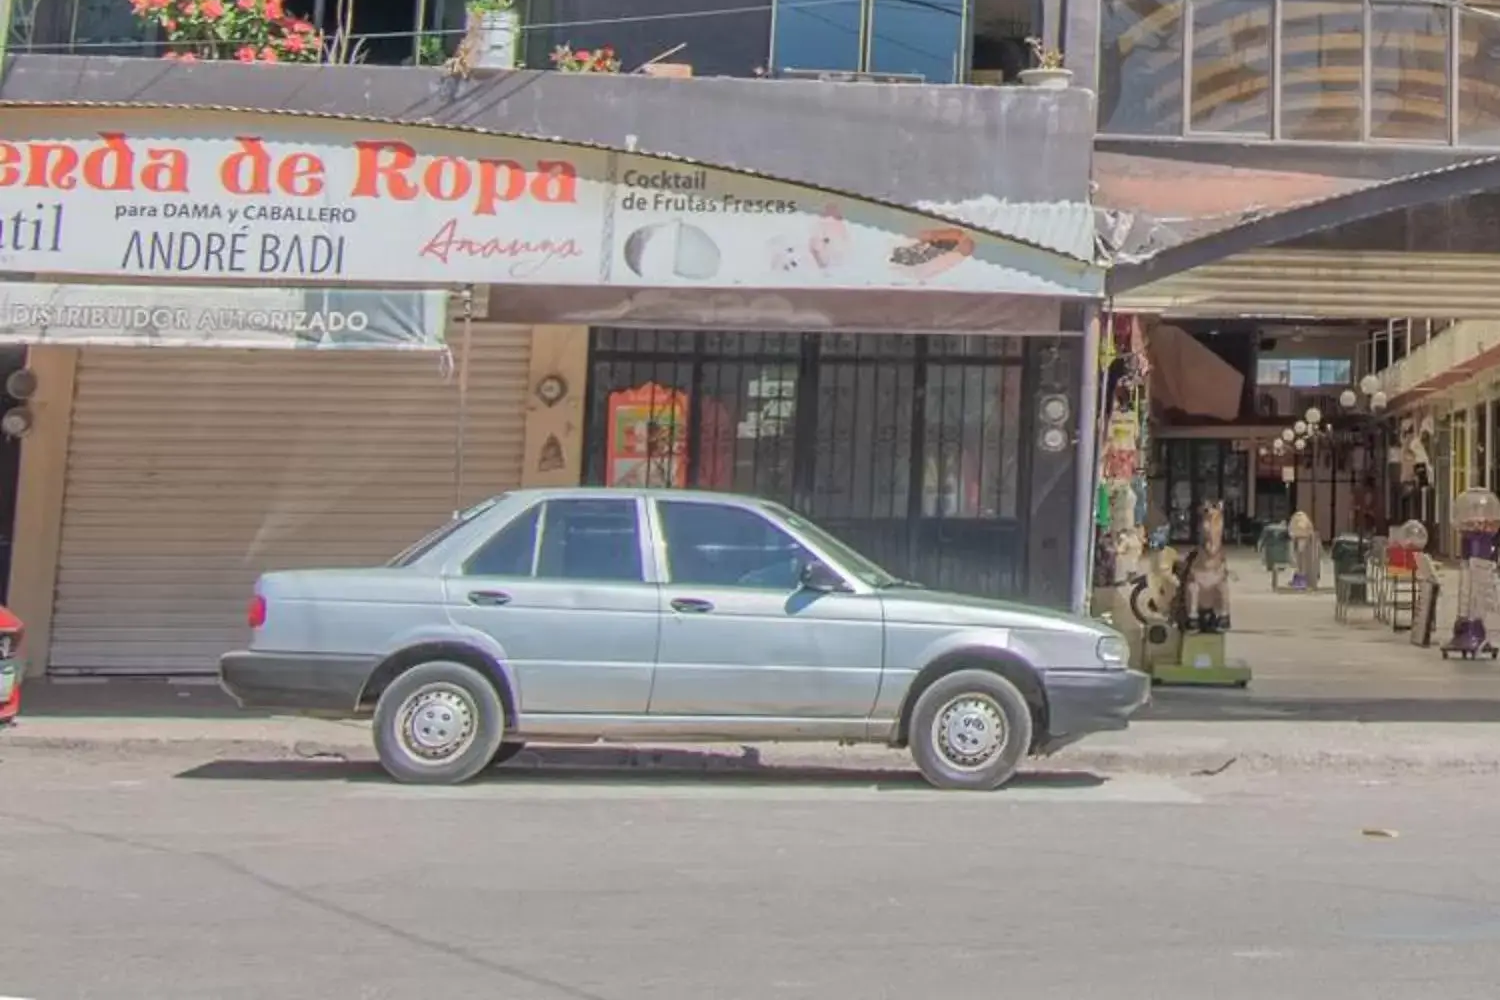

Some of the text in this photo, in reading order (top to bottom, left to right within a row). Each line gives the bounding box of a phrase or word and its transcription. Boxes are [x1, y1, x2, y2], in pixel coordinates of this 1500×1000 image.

[220, 136, 325, 196] de
[351, 141, 577, 216] Ropa
[624, 169, 706, 190] Cocktail
[115, 203, 357, 223] para DAMA y CABALLERO
[622, 193, 798, 215] de Frutas Frescas
[0, 203, 63, 251] til
[259, 233, 345, 274] BADI
[12, 303, 369, 332] DISTRIBUIDOR AUTORIZADO
